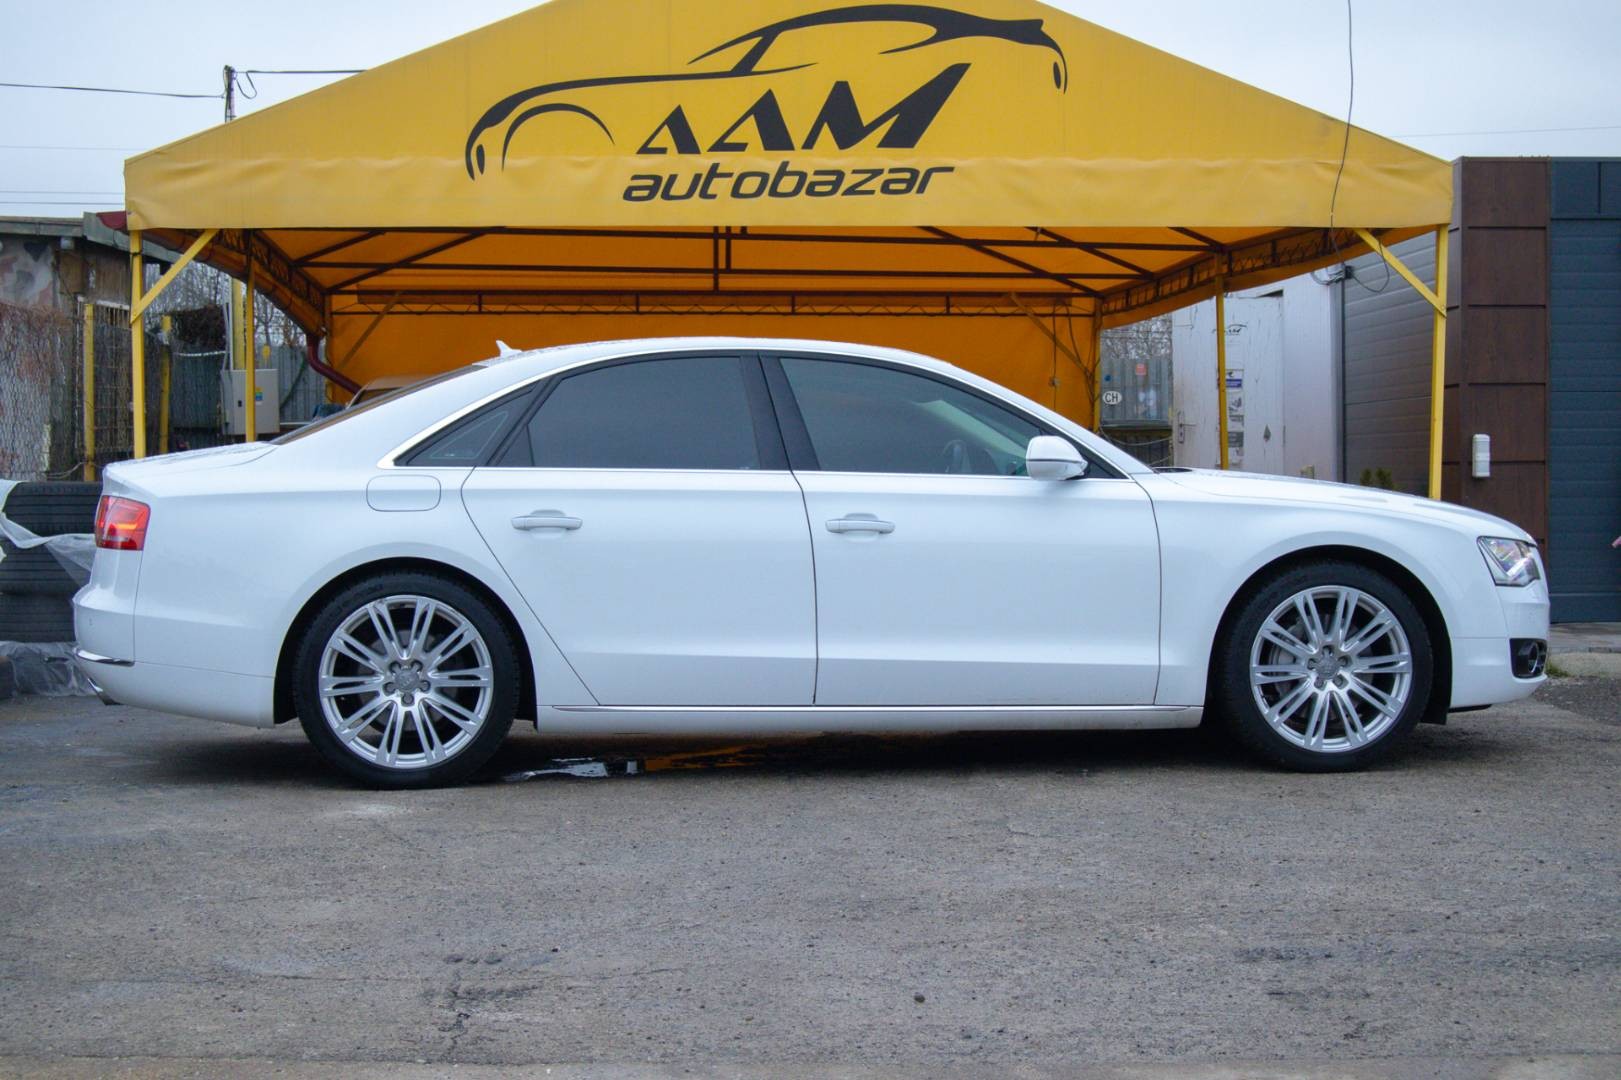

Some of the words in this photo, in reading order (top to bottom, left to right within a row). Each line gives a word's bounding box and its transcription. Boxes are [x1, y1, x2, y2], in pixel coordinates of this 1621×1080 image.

[636, 62, 972, 155] AAM
[622, 160, 955, 202] autobazar
[1105, 392, 1119, 403] CH
